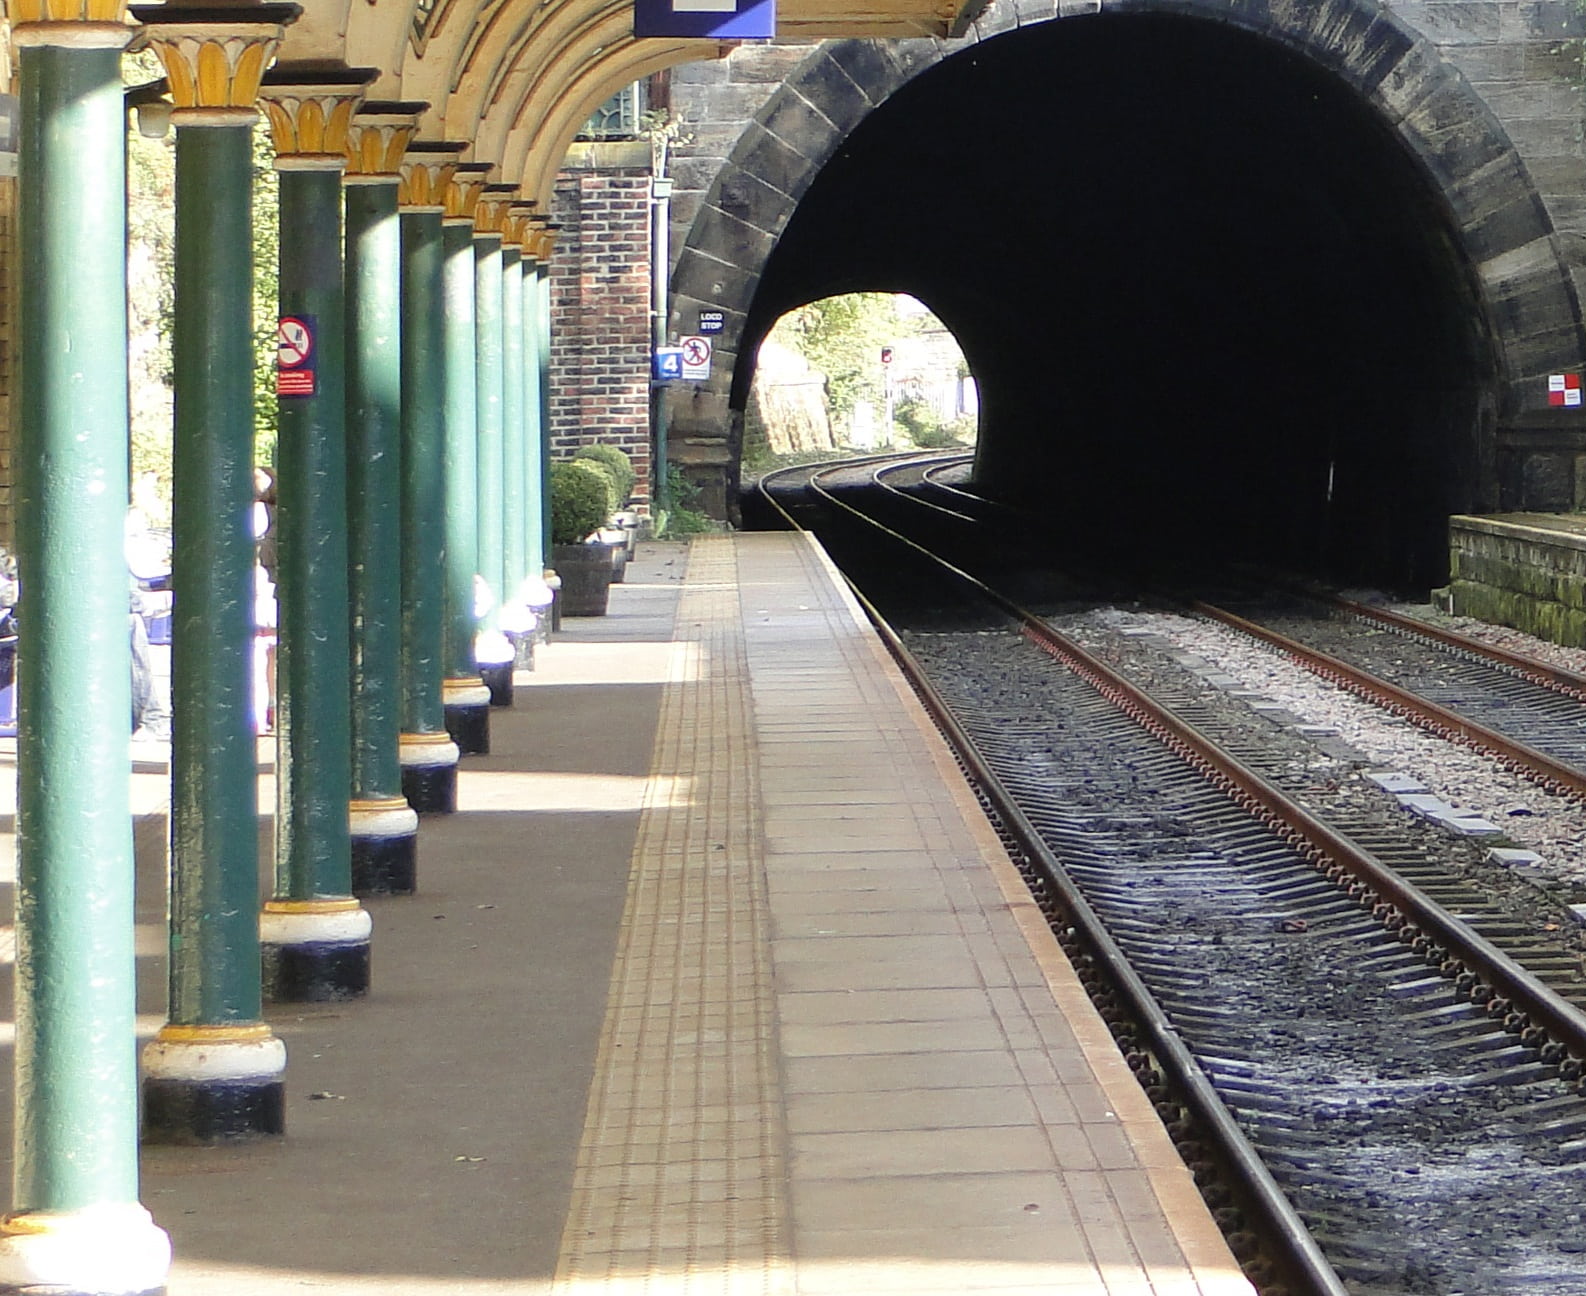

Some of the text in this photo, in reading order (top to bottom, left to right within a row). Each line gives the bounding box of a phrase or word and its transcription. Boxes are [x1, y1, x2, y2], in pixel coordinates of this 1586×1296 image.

[700, 312, 723, 321] LOCO
[700, 322, 723, 330] STOP
[663, 354, 678, 372] 4
